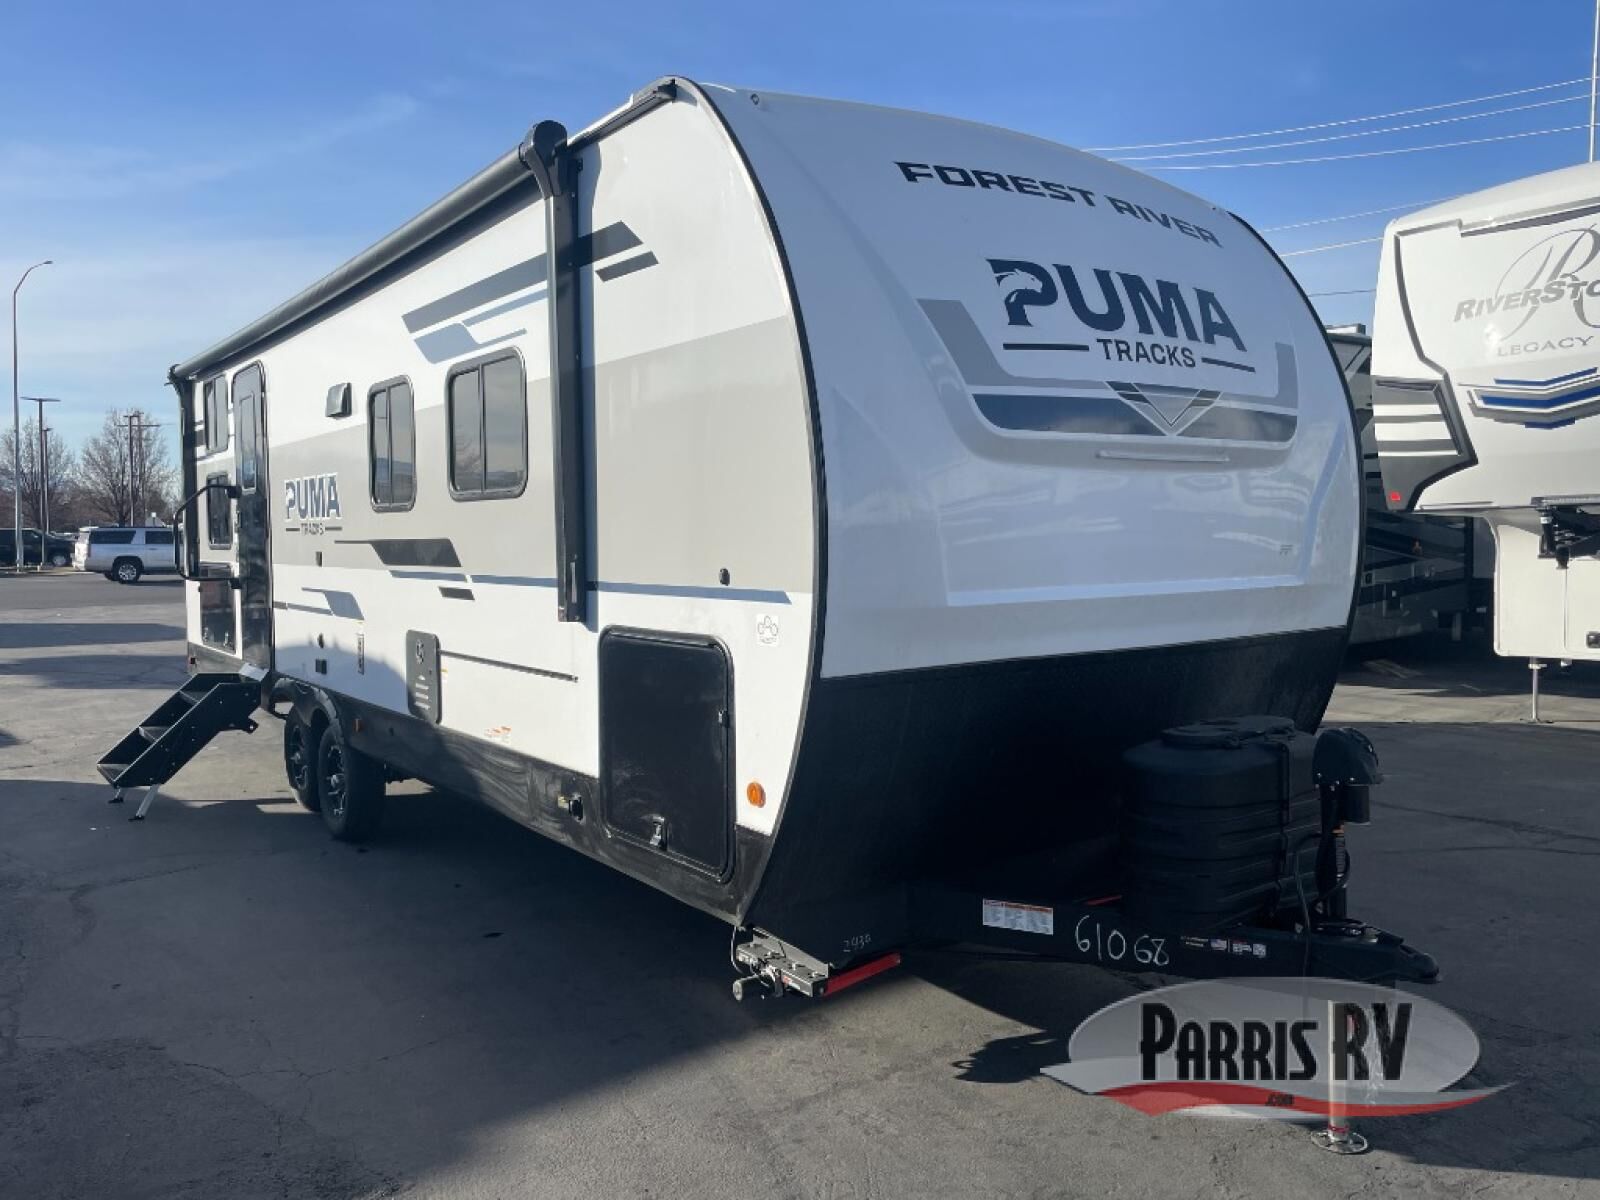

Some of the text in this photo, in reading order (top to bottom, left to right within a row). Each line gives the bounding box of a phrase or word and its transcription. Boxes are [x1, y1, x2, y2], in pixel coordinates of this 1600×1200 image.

[893, 161, 1223, 248] FOREST RIVER
[986, 257, 1248, 353] PUMA
[1096, 337, 1197, 369] TRACKS
[1497, 335, 1595, 358] LEGACY
[284, 473, 342, 521] PUMA
